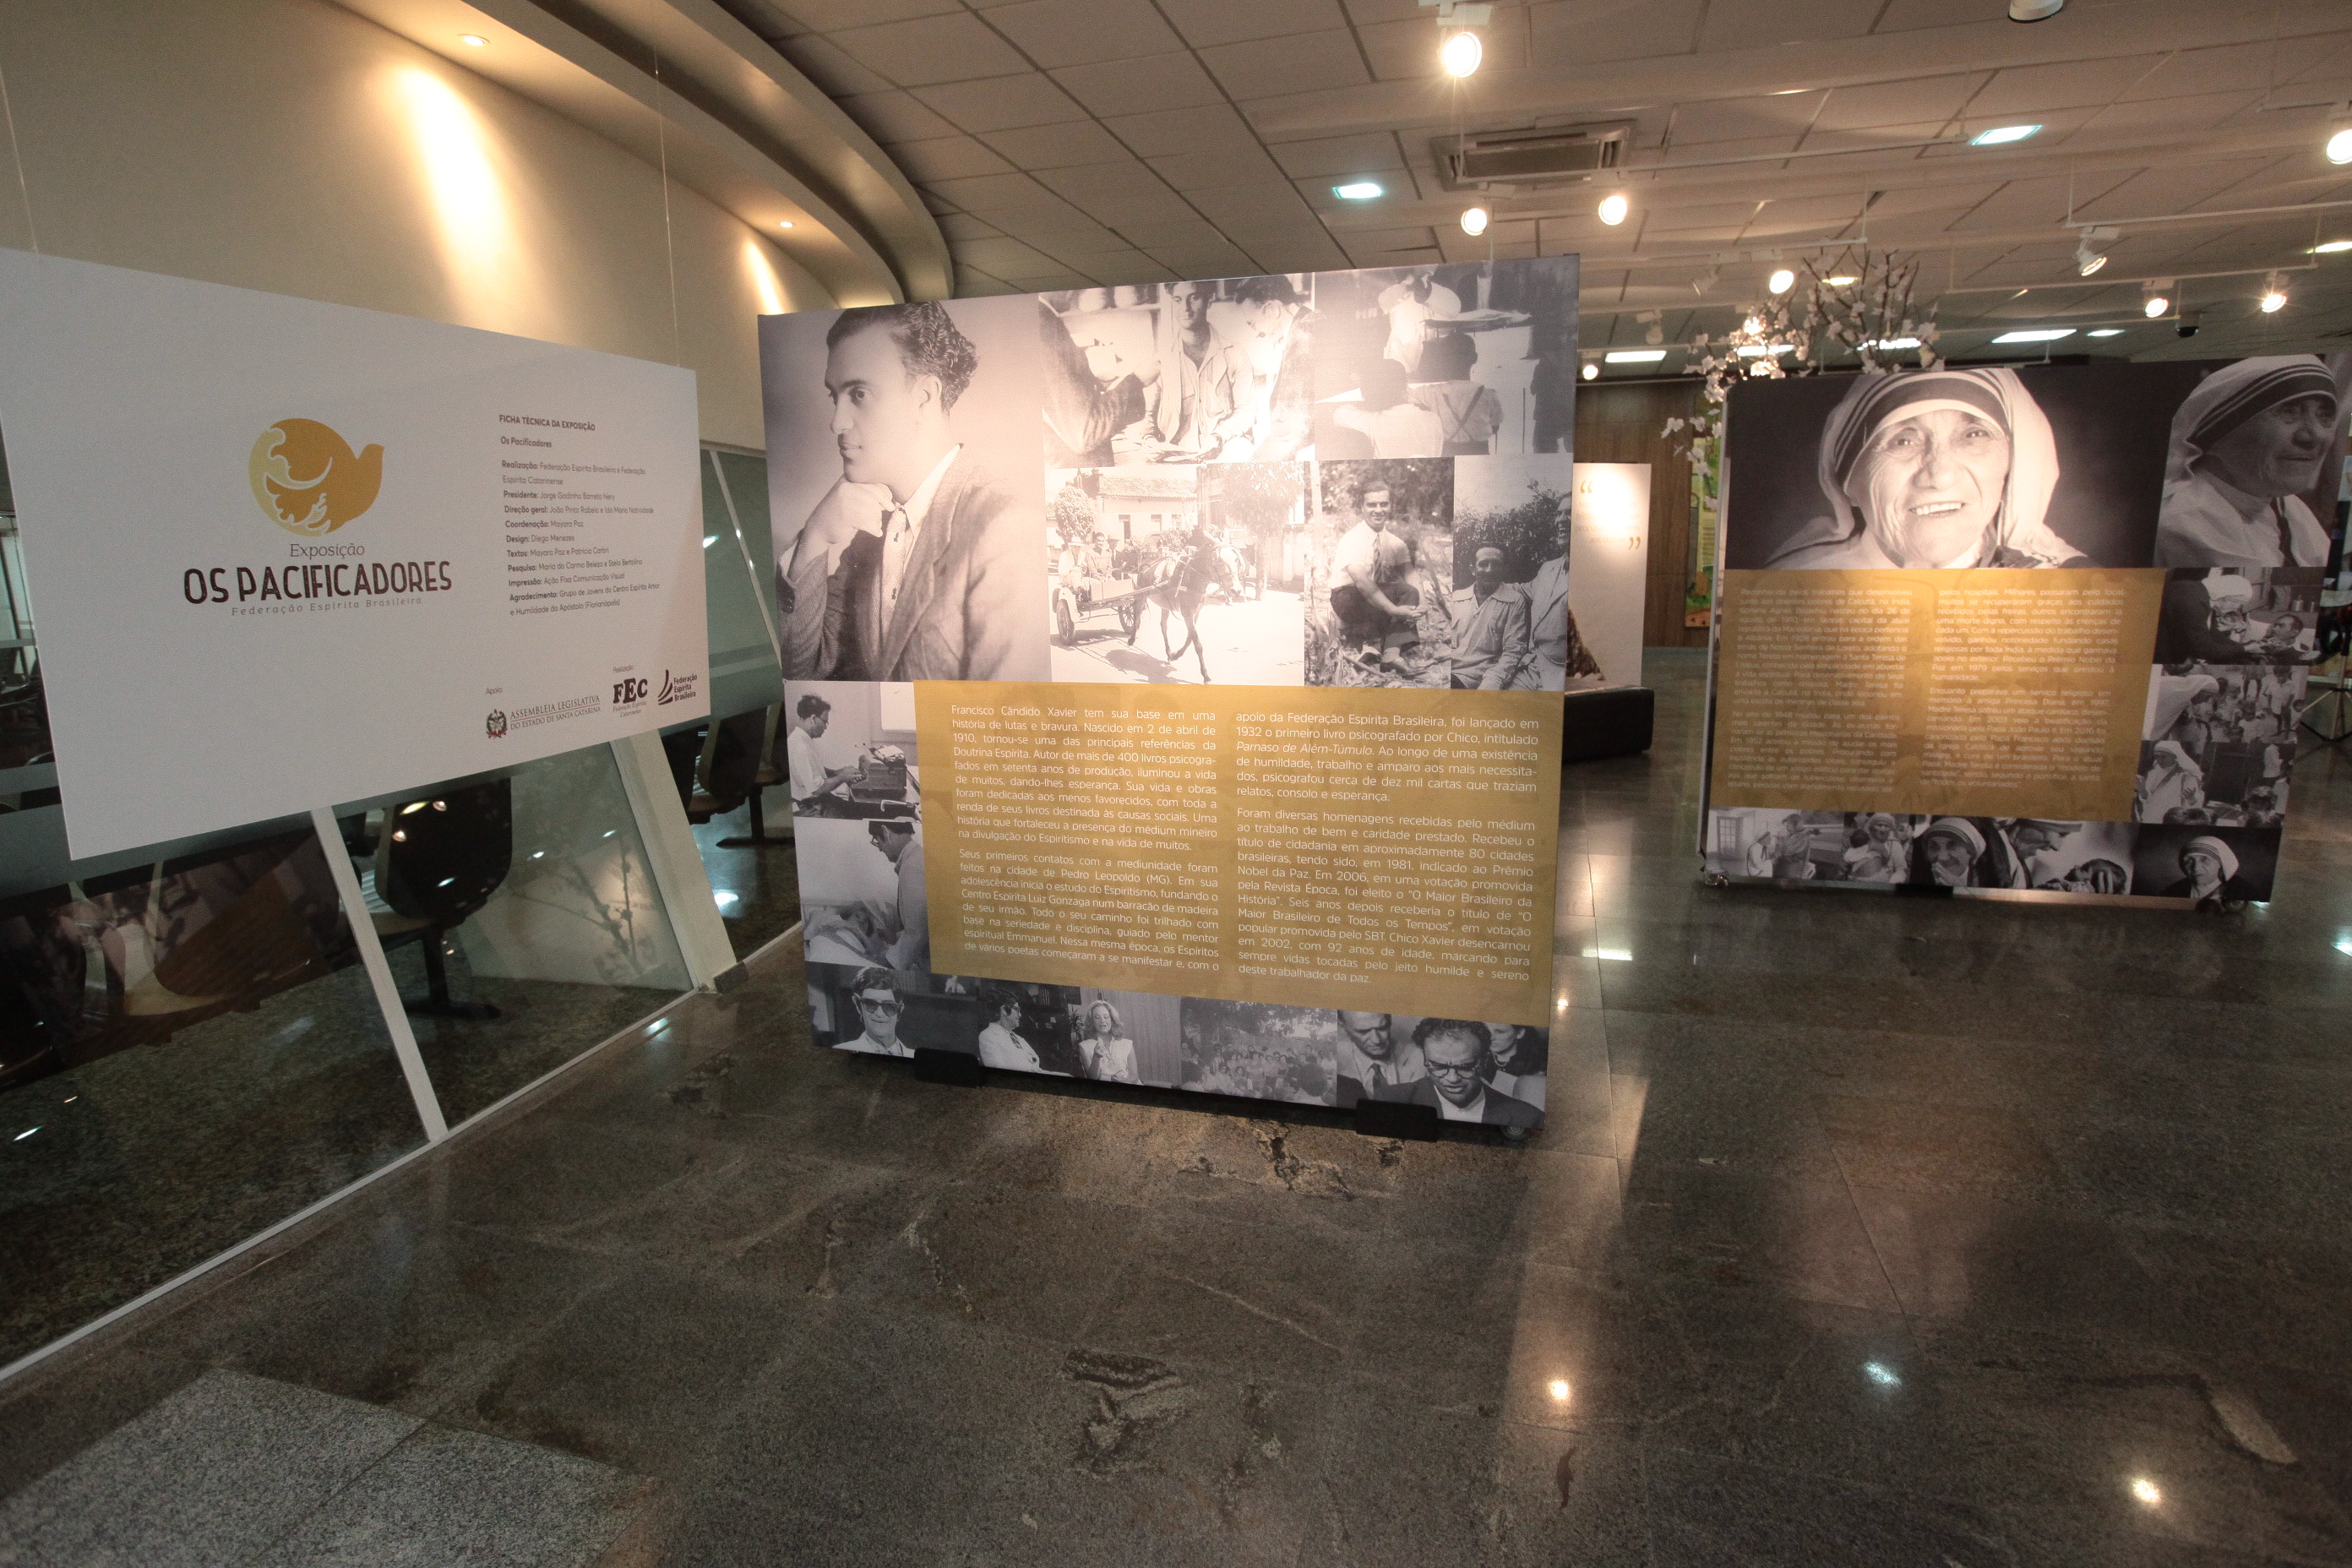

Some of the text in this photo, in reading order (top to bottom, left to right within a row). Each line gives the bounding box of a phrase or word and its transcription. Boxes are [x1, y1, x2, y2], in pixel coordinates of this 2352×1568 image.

[499, 415, 596, 432] FICHA TÉCNICA DA EXPOSIÇÃO
[500, 436, 552, 448] Os Pacificadores
[502, 460, 538, 470] Realização:
[540, 462, 570, 472] Federação
[621, 466, 645, 475] Federação
[503, 475, 564, 486] Espírita Catarinense
[504, 490, 538, 498] Presidente:
[540, 491, 557, 501] Jorge
[558, 492, 581, 500] Godinho
[603, 493, 615, 501] Nery
[504, 505, 530, 514] Direção
[531, 506, 548, 514] geral:
[504, 520, 549, 529] Coordenação:
[551, 520, 572, 529] Mayara
[506, 535, 530, 544] Design:
[531, 535, 549, 544] Diego
[290, 542, 365, 560] Exposição
[531, 549, 553, 558] Mayara
[508, 564, 537, 573] Pesquisa:
[539, 563, 556, 571] Maria
[183, 560, 452, 604] OS PACIFICADORES
[509, 578, 542, 588] Impressão:
[543, 577, 559, 585] Ação
[573, 574, 609, 583] Comunicação
[509, 592, 558, 603] Agradecimento:
[559, 590, 576, 599] Grupo
[231, 596, 422, 616] Federação Espírita Brasileira
[516, 607, 548, 615] Humildade
[559, 602, 584, 612] Apóstolo
[585, 599, 620, 610] (Florianópolis)
[673, 673, 697, 684] Federação
[612, 678, 648, 704] FEC
[674, 690, 696, 701] Brasileira
[509, 694, 601, 720] ASSEMBLEIA LEGISLATIVA
[951, 705, 1216, 721] Francisco Cândido Xavier tem sua base em uma
[509, 722, 521, 731] DO
[523, 718, 547, 728] ESTADO
[556, 712, 573, 722] SANTA
[574, 705, 601, 719] CATARINA
[1236, 712, 1539, 729] apoio da Federação Espírita Brasileira, foi lançado em
[952, 719, 1217, 736] história de lutas e bravura. Nascido em 2 de abril de
[1236, 741, 1538, 761] Parnaso de Além-Túmulo. Ao longo de uma existência
[972, 830, 1021, 841] divulgação
[1023, 833, 1037, 842] do
[1039, 833, 1090, 845] Espiritismo
[1102, 838, 1114, 847] na
[1116, 838, 1137, 847] vida
[1140, 839, 1153, 849] de
[1156, 841, 1192, 851] muitos.
[1236, 837, 1534, 862] título de cidadania em aproximadamente 80 cidades
[1239, 964, 1371, 983] deste trabalhador da paz.
